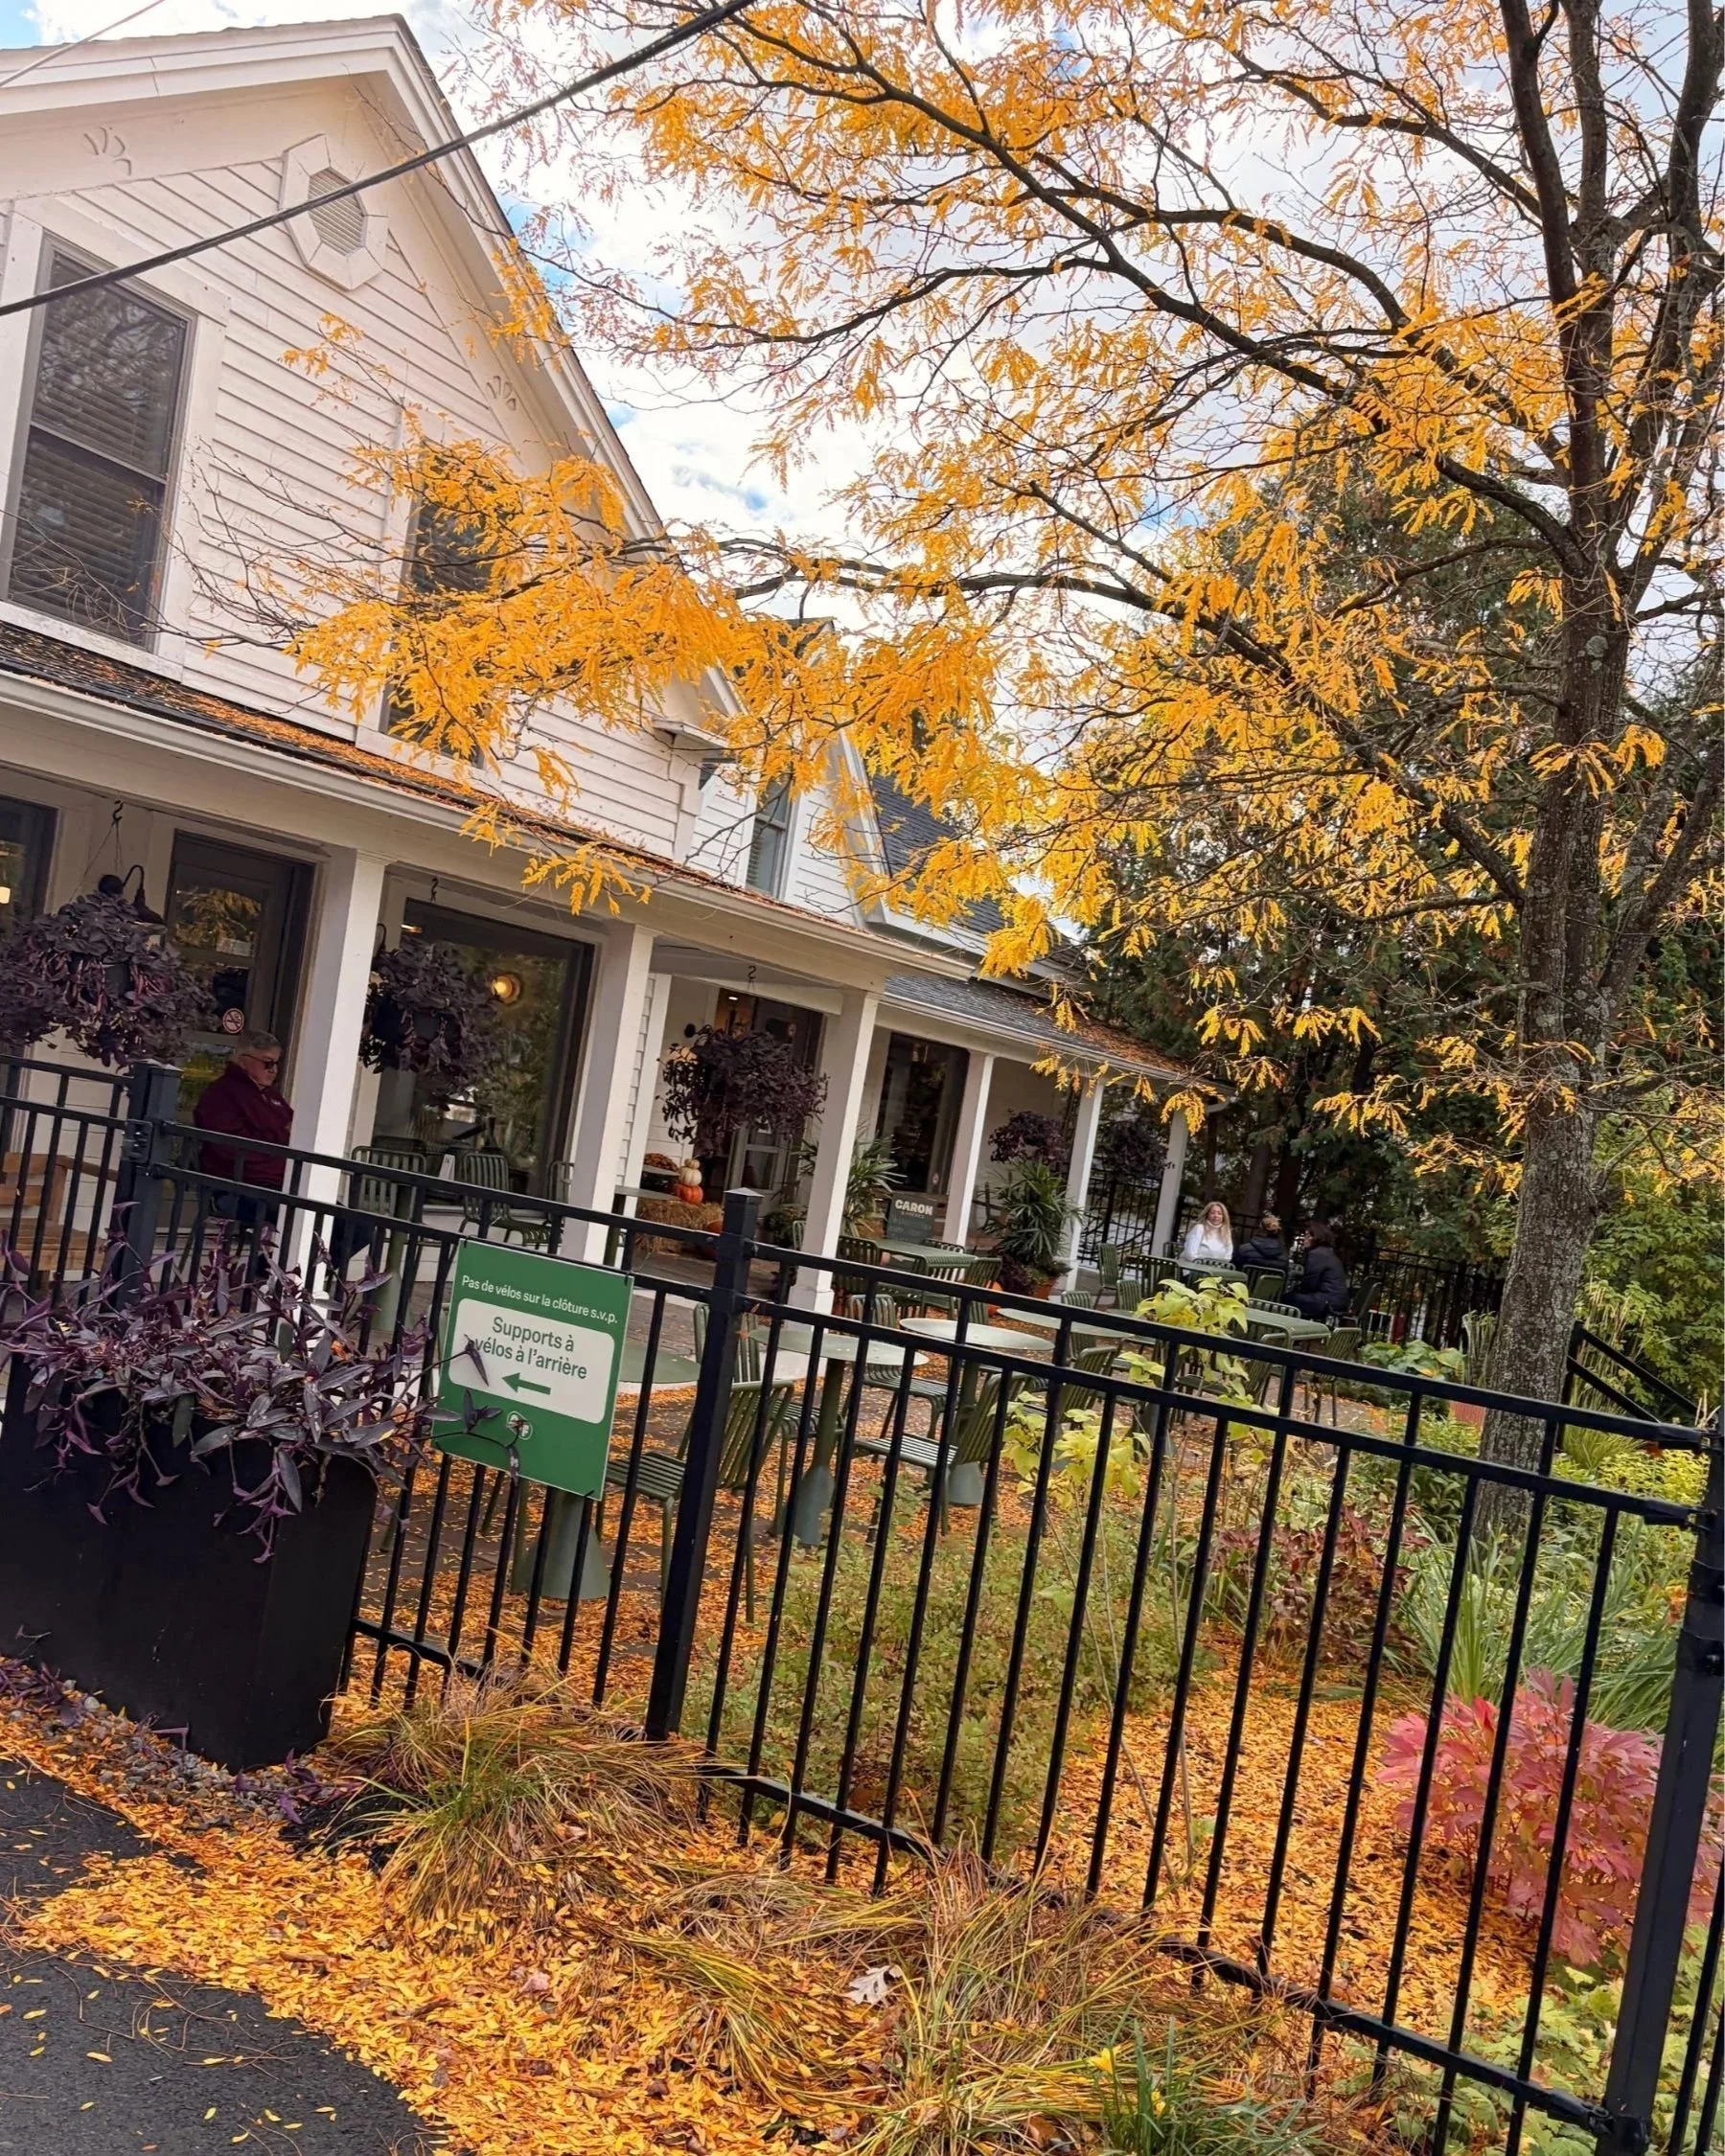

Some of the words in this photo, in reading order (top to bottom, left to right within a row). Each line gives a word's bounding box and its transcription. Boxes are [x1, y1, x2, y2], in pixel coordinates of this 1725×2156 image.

[895, 1199, 933, 1216] CARON
[462, 1274, 480, 1290] Pas
[481, 1280, 494, 1293] de
[495, 1284, 521, 1300] vélos
[522, 1292, 540, 1304] sur
[541, 1294, 551, 1307] la
[552, 1297, 589, 1317] clôture
[590, 1309, 618, 1324] s.v.p.
[492, 1317, 563, 1349] Supports
[564, 1334, 575, 1352] à
[475, 1337, 513, 1360] vélos
[515, 1344, 525, 1363] à
